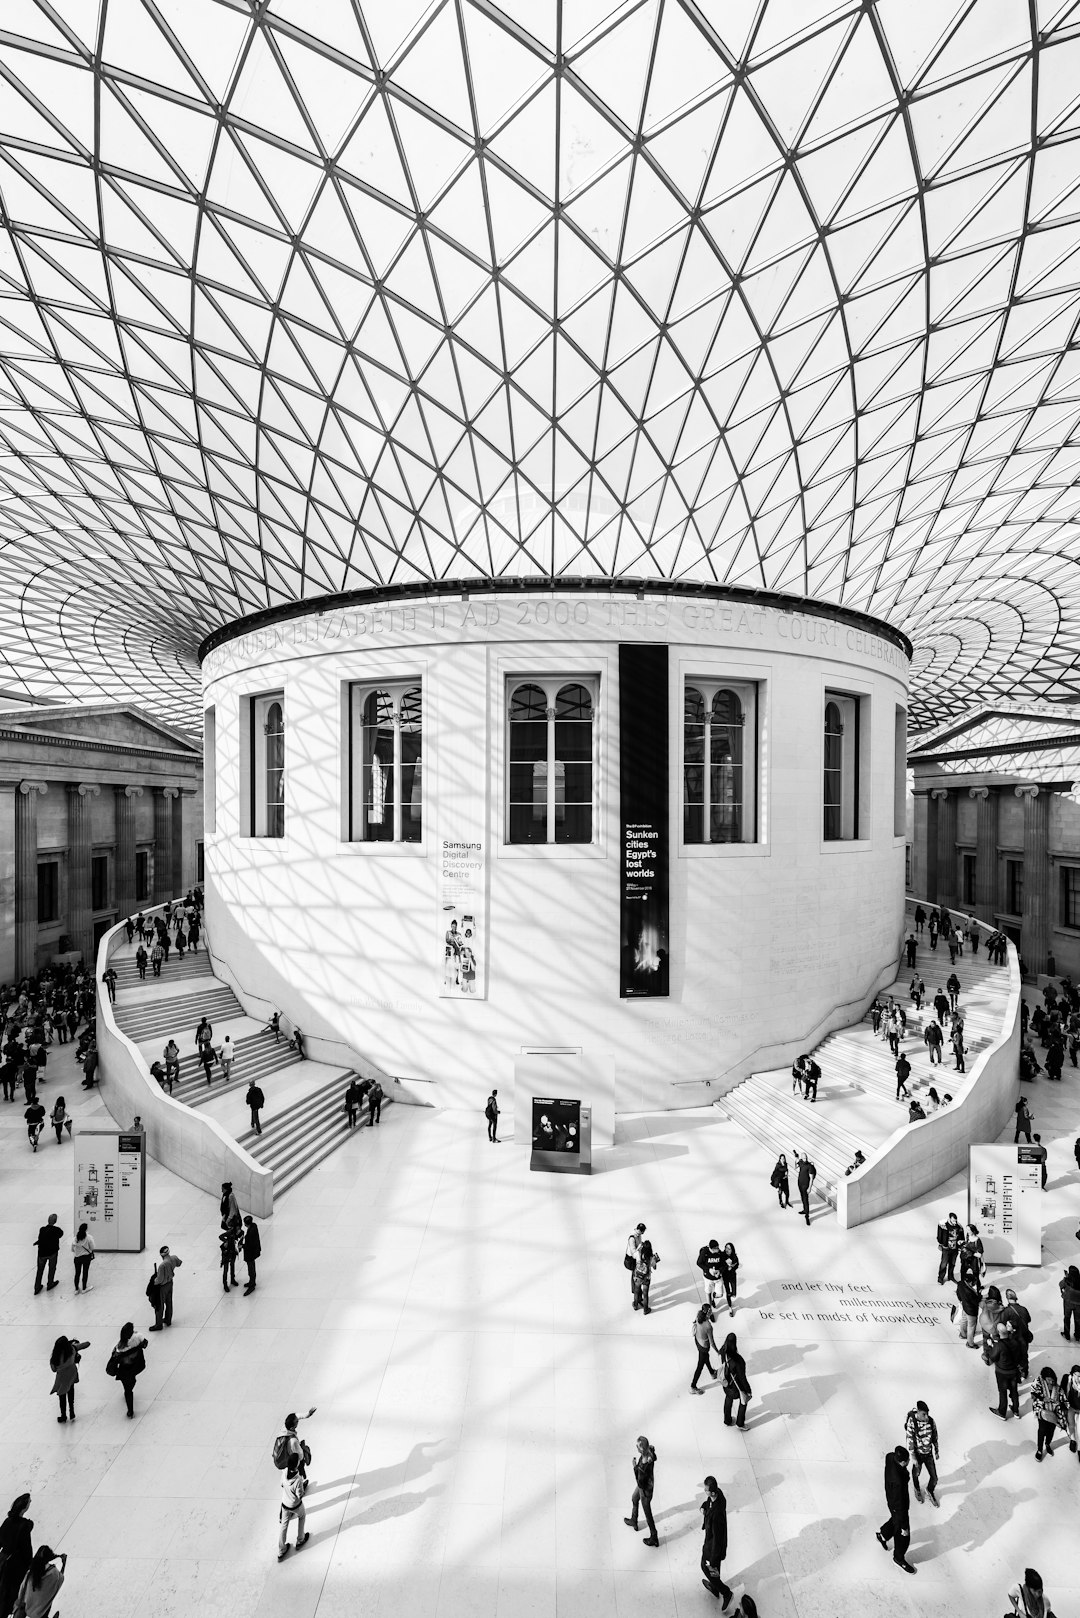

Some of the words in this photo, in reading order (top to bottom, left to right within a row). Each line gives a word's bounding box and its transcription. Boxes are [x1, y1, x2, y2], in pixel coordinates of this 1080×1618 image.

[293, 608, 417, 645] ELIZABETH
[431, 604, 449, 629] II
[460, 602, 500, 628] AD
[516, 601, 590, 626] 2000
[602, 601, 670, 627] THIS
[683, 604, 771, 636] GREAT
[777, 614, 839, 648] COURT
[625, 830, 658, 838] Sunken
[442, 840, 482, 851] Samsung
[625, 840, 649, 849] cities
[442, 850, 469, 860] Digital
[625, 850, 656, 859] Egypt's
[442, 860, 483, 871] Discovery
[625, 860, 643, 869] lost
[442, 869, 470, 878] Centre
[625, 869, 655, 878] worlds
[781, 1282, 803, 1292] and
[806, 1282, 822, 1292] let
[825, 1283, 845, 1294] thy
[848, 1283, 874, 1293] feet
[839, 1297, 914, 1309] millenniums
[916, 1299, 953, 1310] hence
[759, 1310, 774, 1321] be
[779, 1310, 798, 1321] set
[802, 1311, 815, 1321] in
[817, 1311, 852, 1323] midst
[855, 1312, 869, 1323] of
[872, 1312, 940, 1326] knowledge
